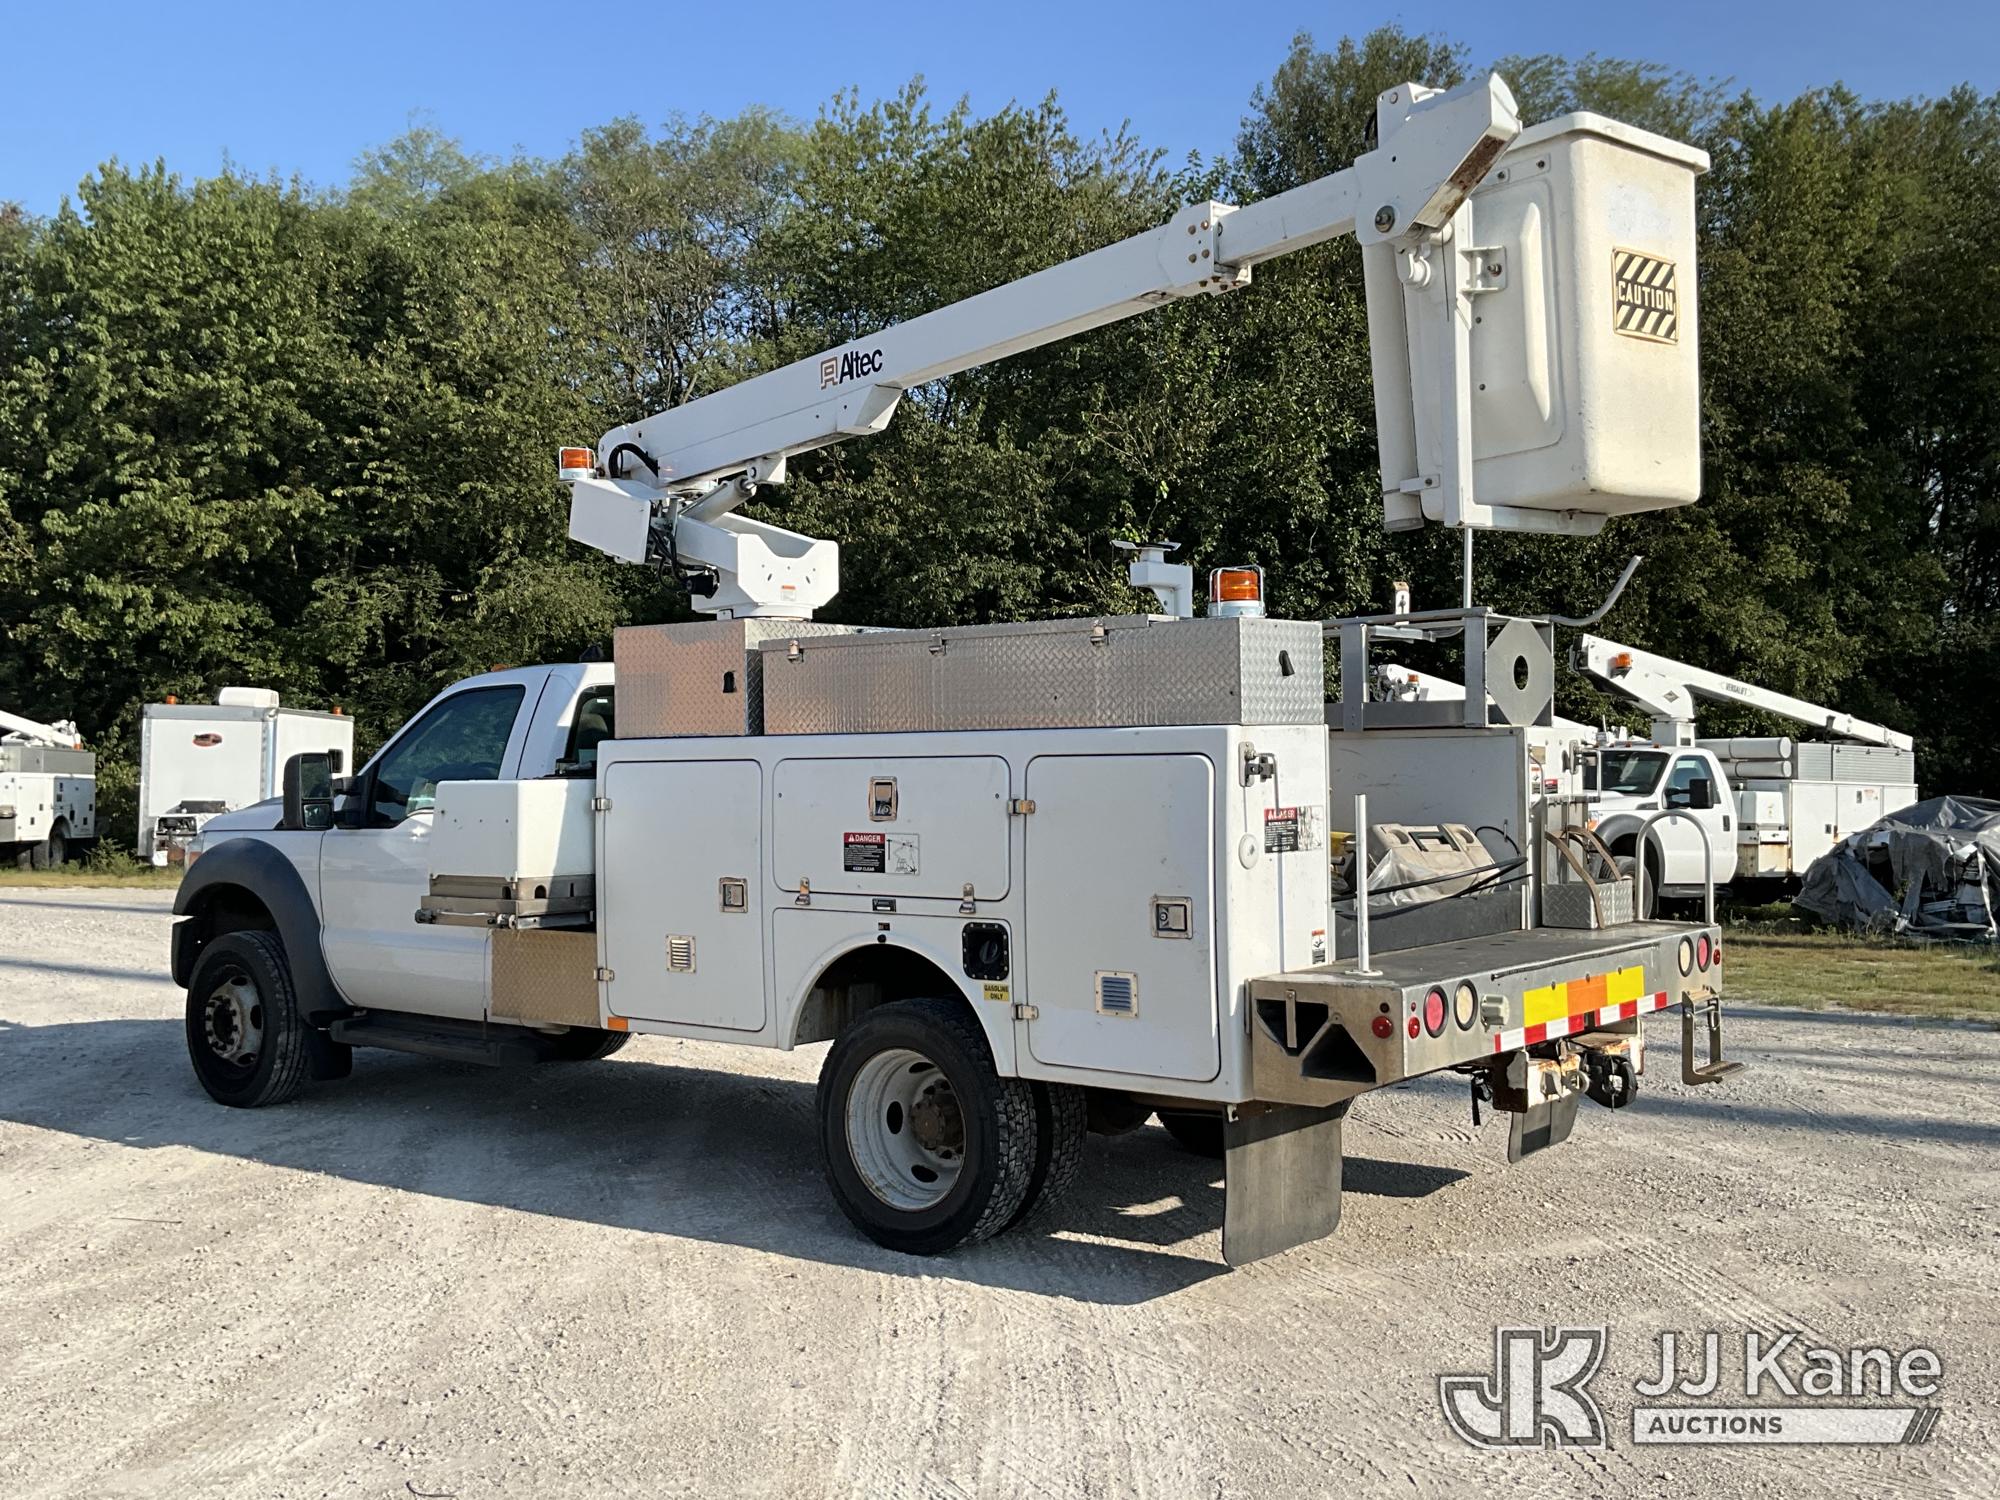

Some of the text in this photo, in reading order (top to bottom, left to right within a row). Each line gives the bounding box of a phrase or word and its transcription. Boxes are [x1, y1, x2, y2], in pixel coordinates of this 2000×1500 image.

[1618, 280, 1673, 311] CAUTION
[839, 349, 882, 384] Altec
[855, 834, 881, 843] DANGER
[984, 984, 1008, 993] GASOLINE
[990, 992, 1004, 1000] ONLY
